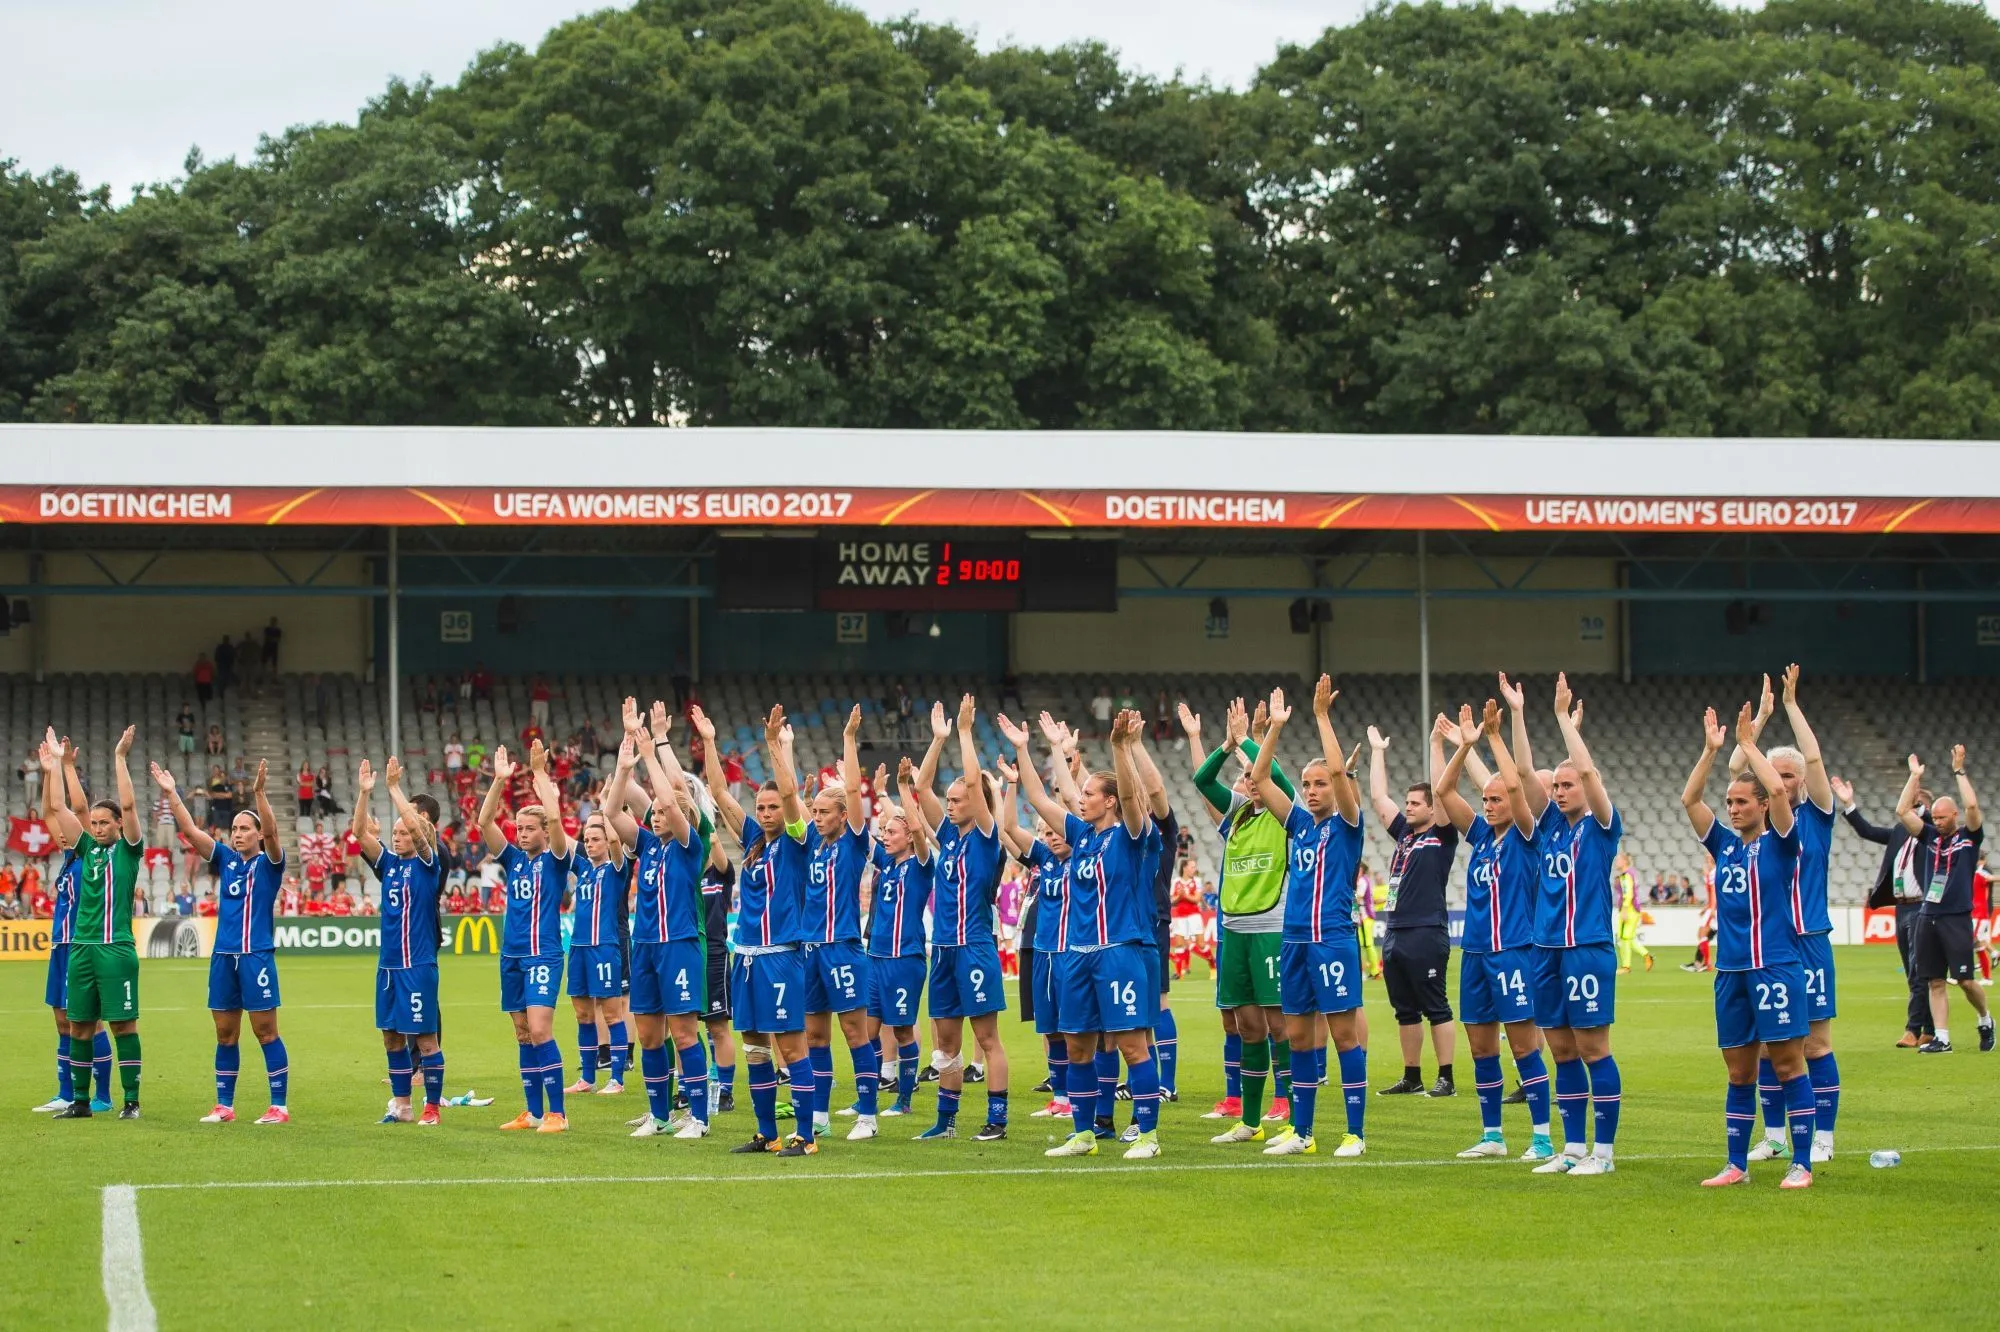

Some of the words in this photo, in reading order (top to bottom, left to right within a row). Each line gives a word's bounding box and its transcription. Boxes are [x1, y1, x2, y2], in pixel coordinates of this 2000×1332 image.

[39, 492, 232, 518] DOETINCHEM
[493, 493, 565, 518] UEFA
[566, 493, 701, 519] WOMEN'S
[705, 493, 780, 518] EURO
[783, 493, 853, 518] 2017
[1105, 495, 1285, 523] DOETINCHEM
[1526, 499, 1594, 524] UEFA
[1594, 500, 1718, 526] WOMEN'S
[1721, 501, 1792, 526] EURO
[1794, 502, 1858, 526] 2017
[838, 543, 930, 563] HOME
[943, 543, 950, 562] 1
[838, 564, 931, 586] AWAY
[937, 565, 950, 586] 2
[444, 613, 469, 630] 36
[840, 615, 863, 631] 37
[1231, 856, 1272, 873] RESPECT
[1295, 848, 1316, 873] 19
[1545, 843, 1573, 868] 20
[644, 867, 656, 885] 4
[809, 862, 825, 884] 15
[944, 859, 954, 881] 9
[1721, 866, 1748, 894] 23
[228, 879, 240, 896] 6
[388, 888, 399, 907] 5
[512, 879, 532, 900] 18
[580, 884, 592, 900] 11
[883, 882, 893, 901] 2
[257, 967, 269, 987] 6
[528, 965, 550, 984] 18
[596, 962, 612, 981] 11
[675, 968, 689, 989] 4
[830, 965, 855, 989] 15
[970, 969, 985, 992] 9
[1319, 961, 1345, 987] 19
[1497, 969, 1525, 996] 14
[1804, 968, 1825, 994] 21
[123, 980, 131, 1000] 1
[773, 982, 786, 1006] 7
[895, 987, 908, 1008] 2
[1110, 980, 1136, 1005] 16
[1566, 974, 1599, 1001] 20
[1756, 982, 1790, 1010] 23
[410, 992, 423, 1013] 5
